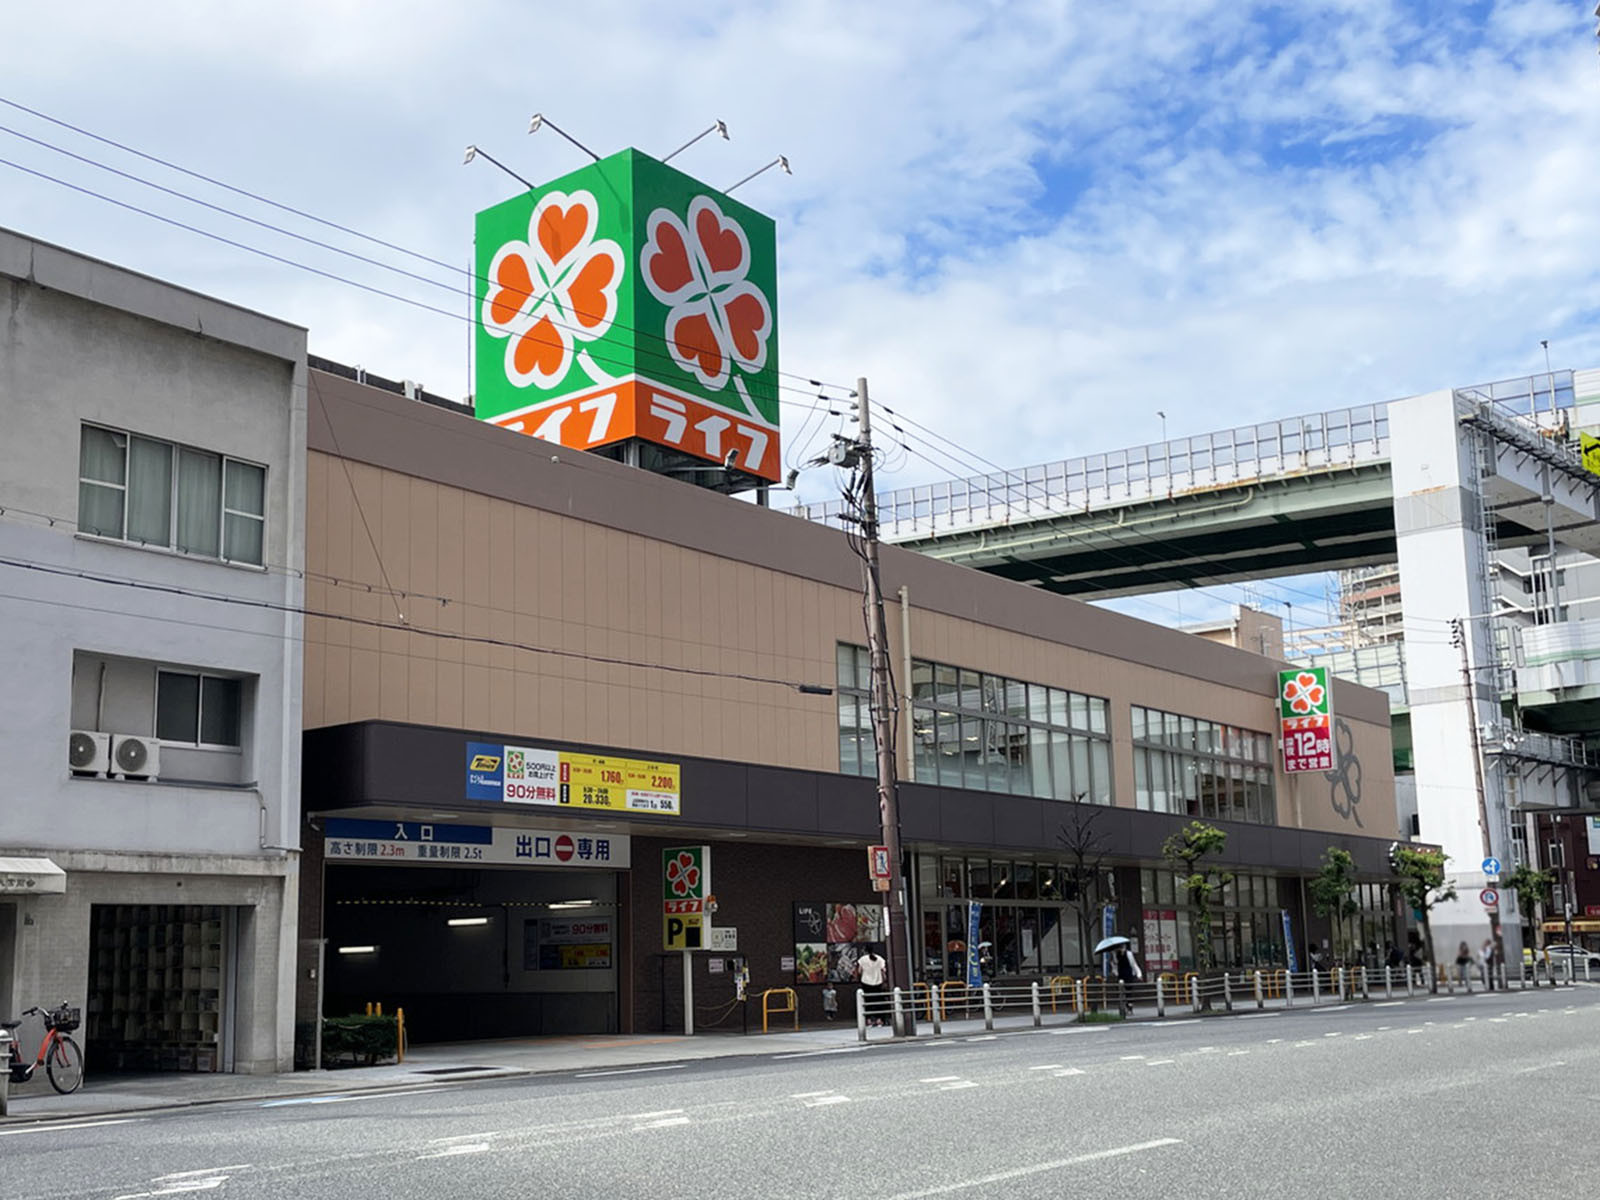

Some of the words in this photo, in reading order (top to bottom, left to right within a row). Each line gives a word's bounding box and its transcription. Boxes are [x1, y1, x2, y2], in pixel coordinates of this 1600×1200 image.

[502, 393, 617, 445] イフ
[651, 393, 768, 470] ライフ
[1287, 717, 1324, 729] ライフ
[506, 784, 556, 801] 90分無料
[395, 824, 434, 841] 入口
[330, 841, 378, 857] 高さ制限
[380, 844, 405, 857] 2.3m
[417, 844, 461, 860] 重量制限
[464, 847, 482, 860] 2.5t
[516, 835, 552, 859] 出口
[577, 837, 610, 861] 専用
[669, 901, 701, 913] ライフ
[798, 907, 813, 915] LIFE
[668, 918, 684, 946] P
